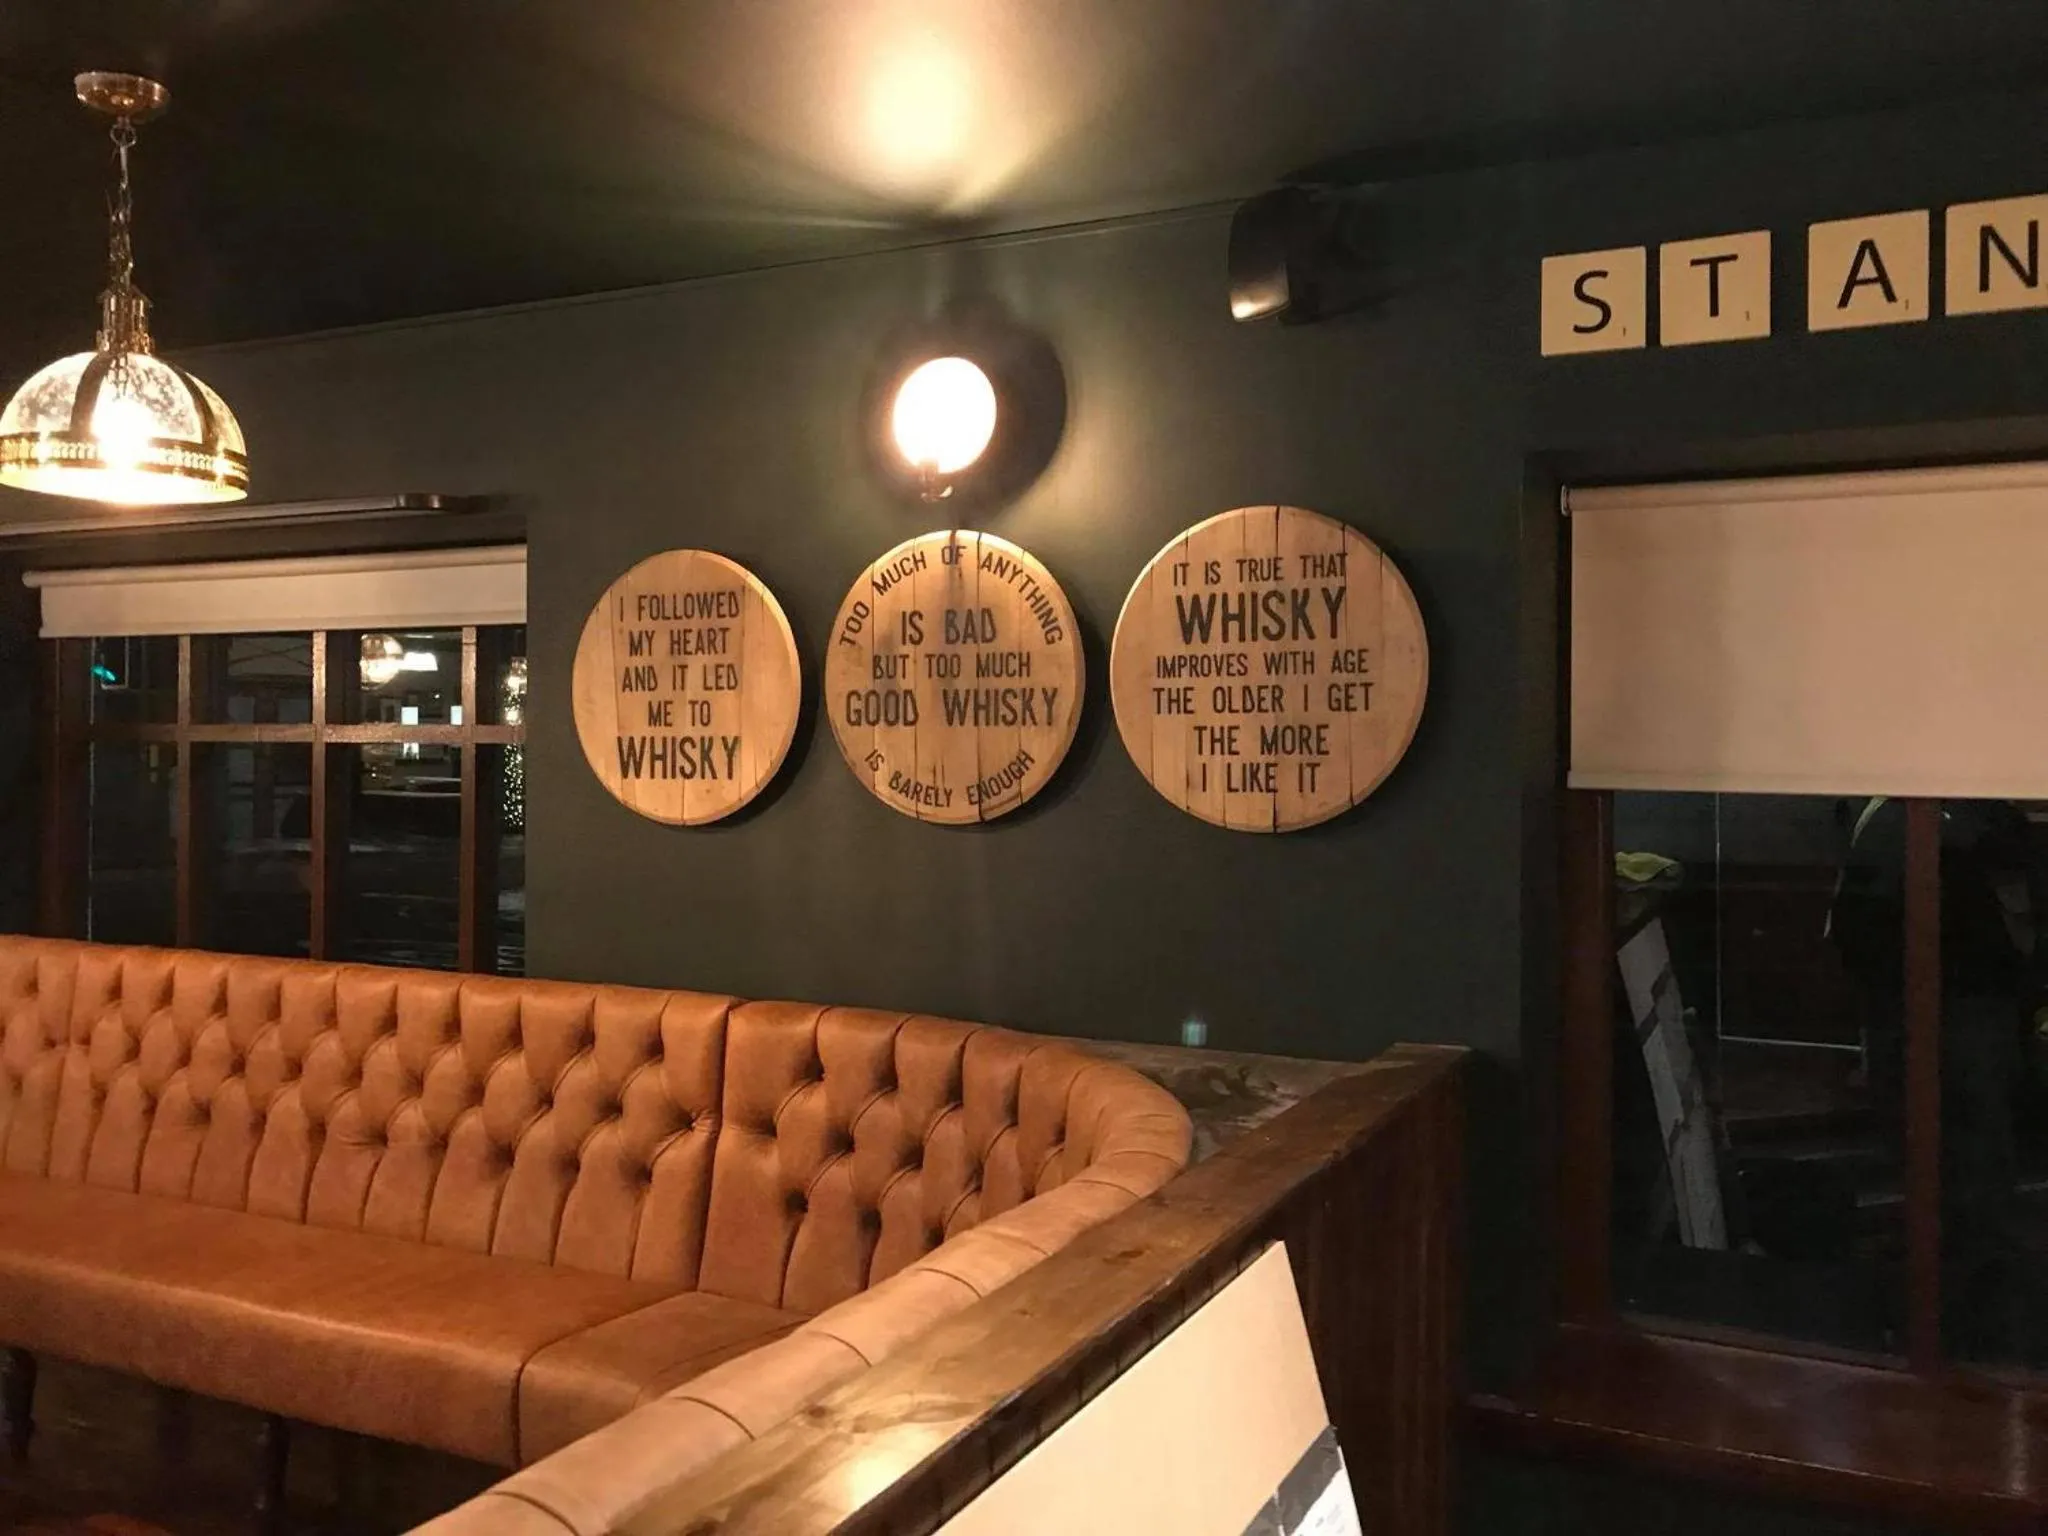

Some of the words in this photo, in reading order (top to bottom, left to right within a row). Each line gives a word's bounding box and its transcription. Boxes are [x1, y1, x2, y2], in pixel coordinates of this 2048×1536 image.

[1173, 562, 1190, 586] IT
[1204, 561, 1221, 585] IS
[1236, 558, 1283, 582] TRUE
[1300, 553, 1348, 580] THAT
[619, 596, 624, 622] I
[638, 592, 740, 621] FOLLOWED
[839, 600, 870, 648] TOO
[872, 552, 927, 596] MUCH
[941, 546, 967, 565] OF
[980, 552, 1063, 646] ANYTHING
[902, 611, 924, 646] IS
[945, 607, 996, 645] BAD
[1175, 586, 1346, 645] WHISKY
[628, 630, 655, 656] MY
[670, 627, 730, 656] HEART
[622, 665, 657, 692] AND
[672, 665, 688, 691] IT
[703, 664, 738, 691] LED
[873, 655, 910, 680] BUT
[925, 654, 961, 678] TOO
[976, 652, 1031, 678] MUCH
[1157, 653, 1248, 679] IMPROVES
[1263, 651, 1314, 675] WITH
[1331, 649, 1369, 674] AGE
[648, 701, 673, 727] ME
[689, 700, 711, 726] TO
[846, 689, 919, 727] GOOD
[941, 687, 1059, 727] WHISKY
[1153, 687, 1195, 714] THE
[1213, 686, 1284, 713] OLDER
[1303, 684, 1308, 712] I
[1328, 683, 1374, 712] GET
[1194, 725, 1240, 756] THE
[1260, 724, 1329, 755] MORE
[617, 736, 740, 780] WHISKY
[864, 748, 885, 772] IS
[888, 770, 953, 807] BARELY
[966, 750, 1035, 805] ENOUGH
[1202, 763, 1207, 792] I
[1226, 763, 1278, 793] LIKE
[1298, 762, 1320, 793] IT
